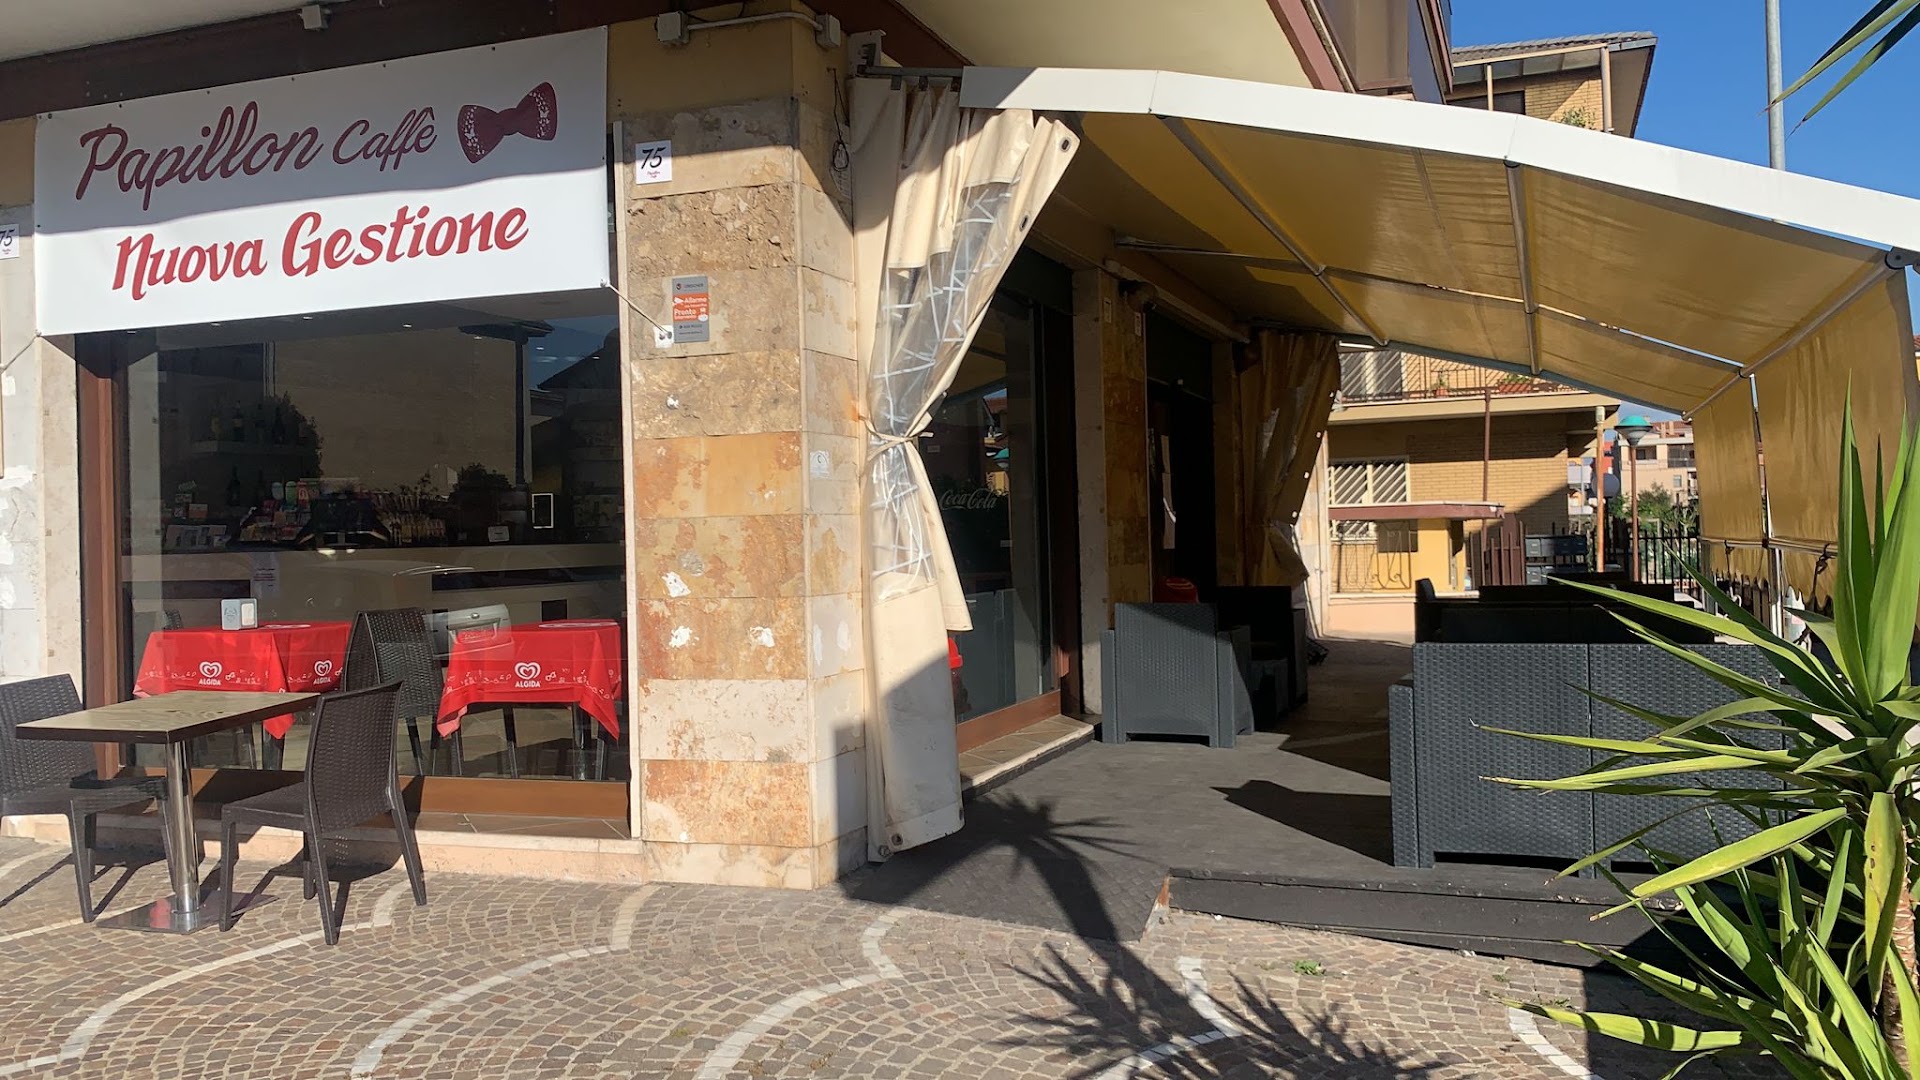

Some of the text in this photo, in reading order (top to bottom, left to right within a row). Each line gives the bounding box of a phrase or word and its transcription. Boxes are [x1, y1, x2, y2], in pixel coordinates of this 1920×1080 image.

[76, 101, 438, 211] Papillon Caffè
[641, 146, 667, 170] 75
[0, 228, 16, 247] 75
[112, 205, 529, 301] Nuova Gestione
[199, 678, 221, 686] ALGIDA
[313, 677, 331, 685] ALGIDA
[515, 680, 541, 688] ALGIDA
